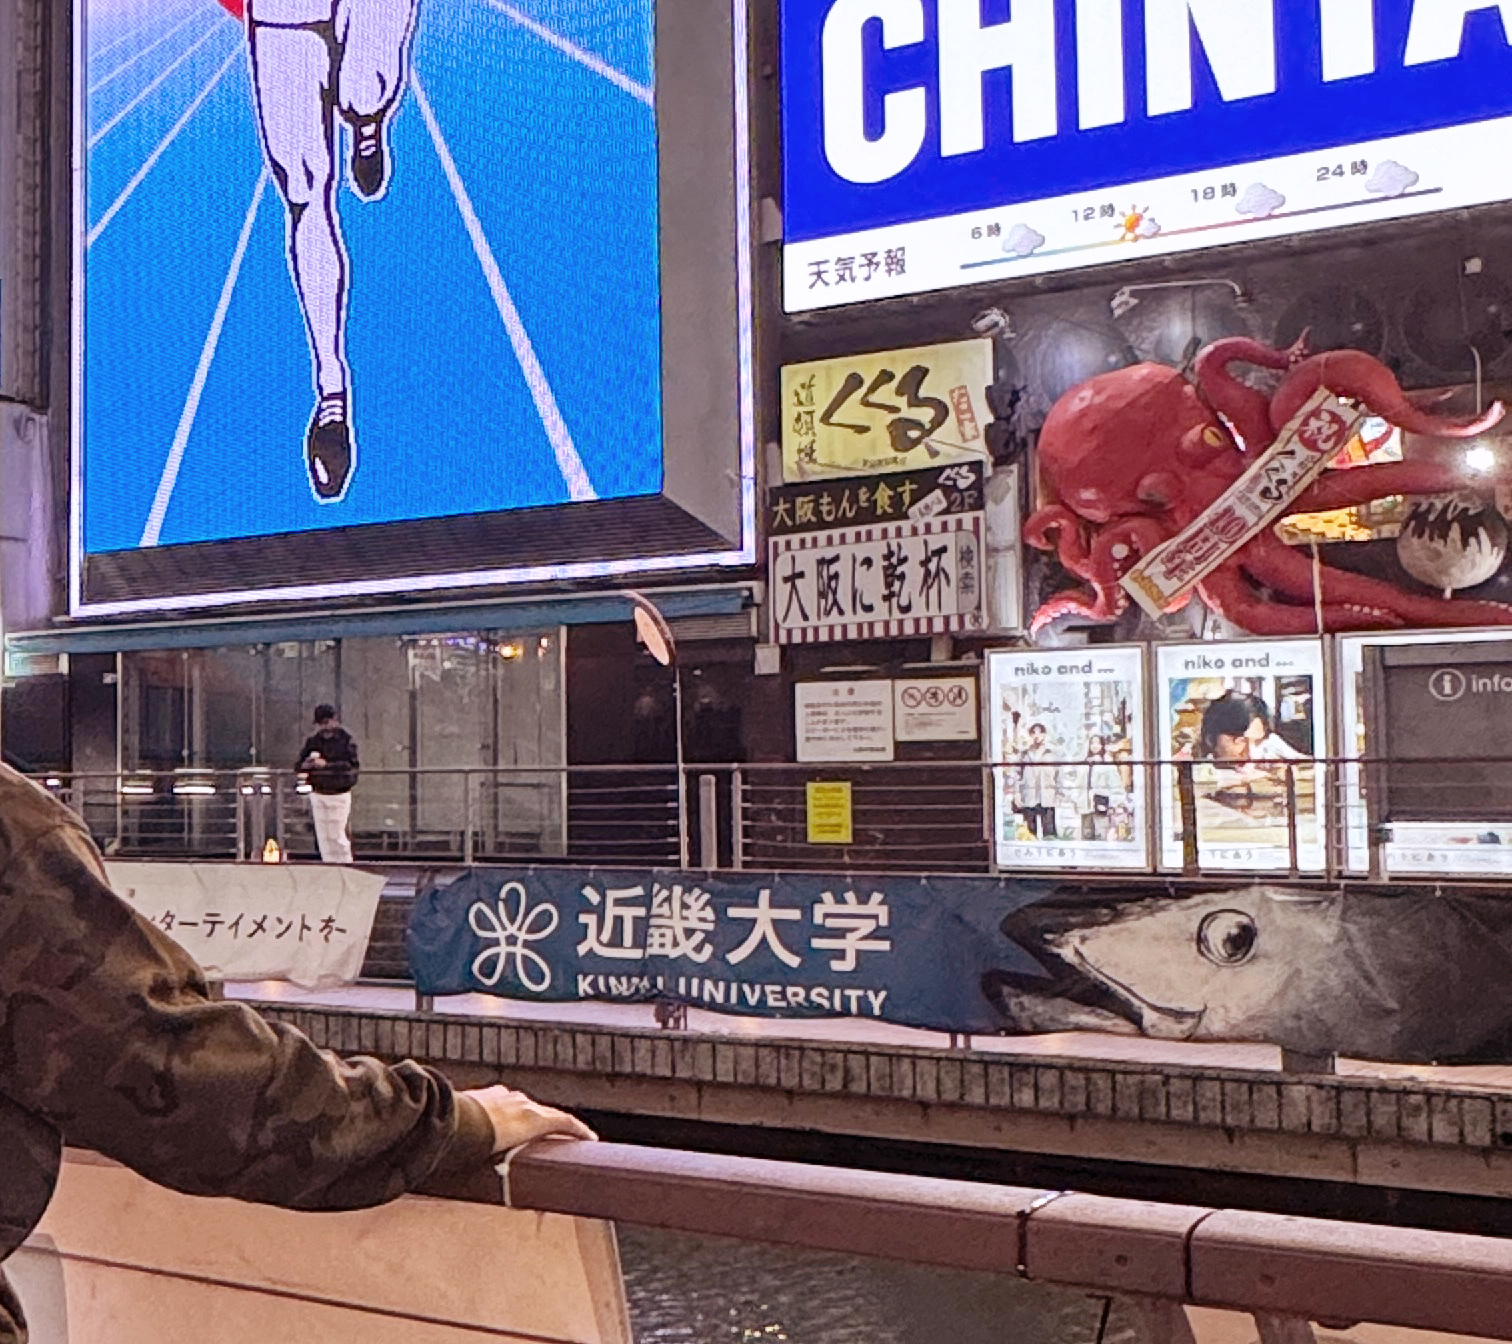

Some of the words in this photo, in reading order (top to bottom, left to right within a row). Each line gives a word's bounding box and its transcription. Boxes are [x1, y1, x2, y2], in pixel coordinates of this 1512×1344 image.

[806, 246, 908, 291] 天気予報
[818, 364, 950, 453] くくる
[1301, 410, 1343, 450] 祝
[772, 478, 919, 529] 大阪もんを食す
[781, 537, 952, 625] 大阪に乾杯
[1056, 659, 1093, 676] and
[1183, 654, 1226, 671] niko
[1230, 651, 1270, 669] and
[150, 909, 349, 945] ターテイメントを
[576, 881, 891, 973] 近畿大学
